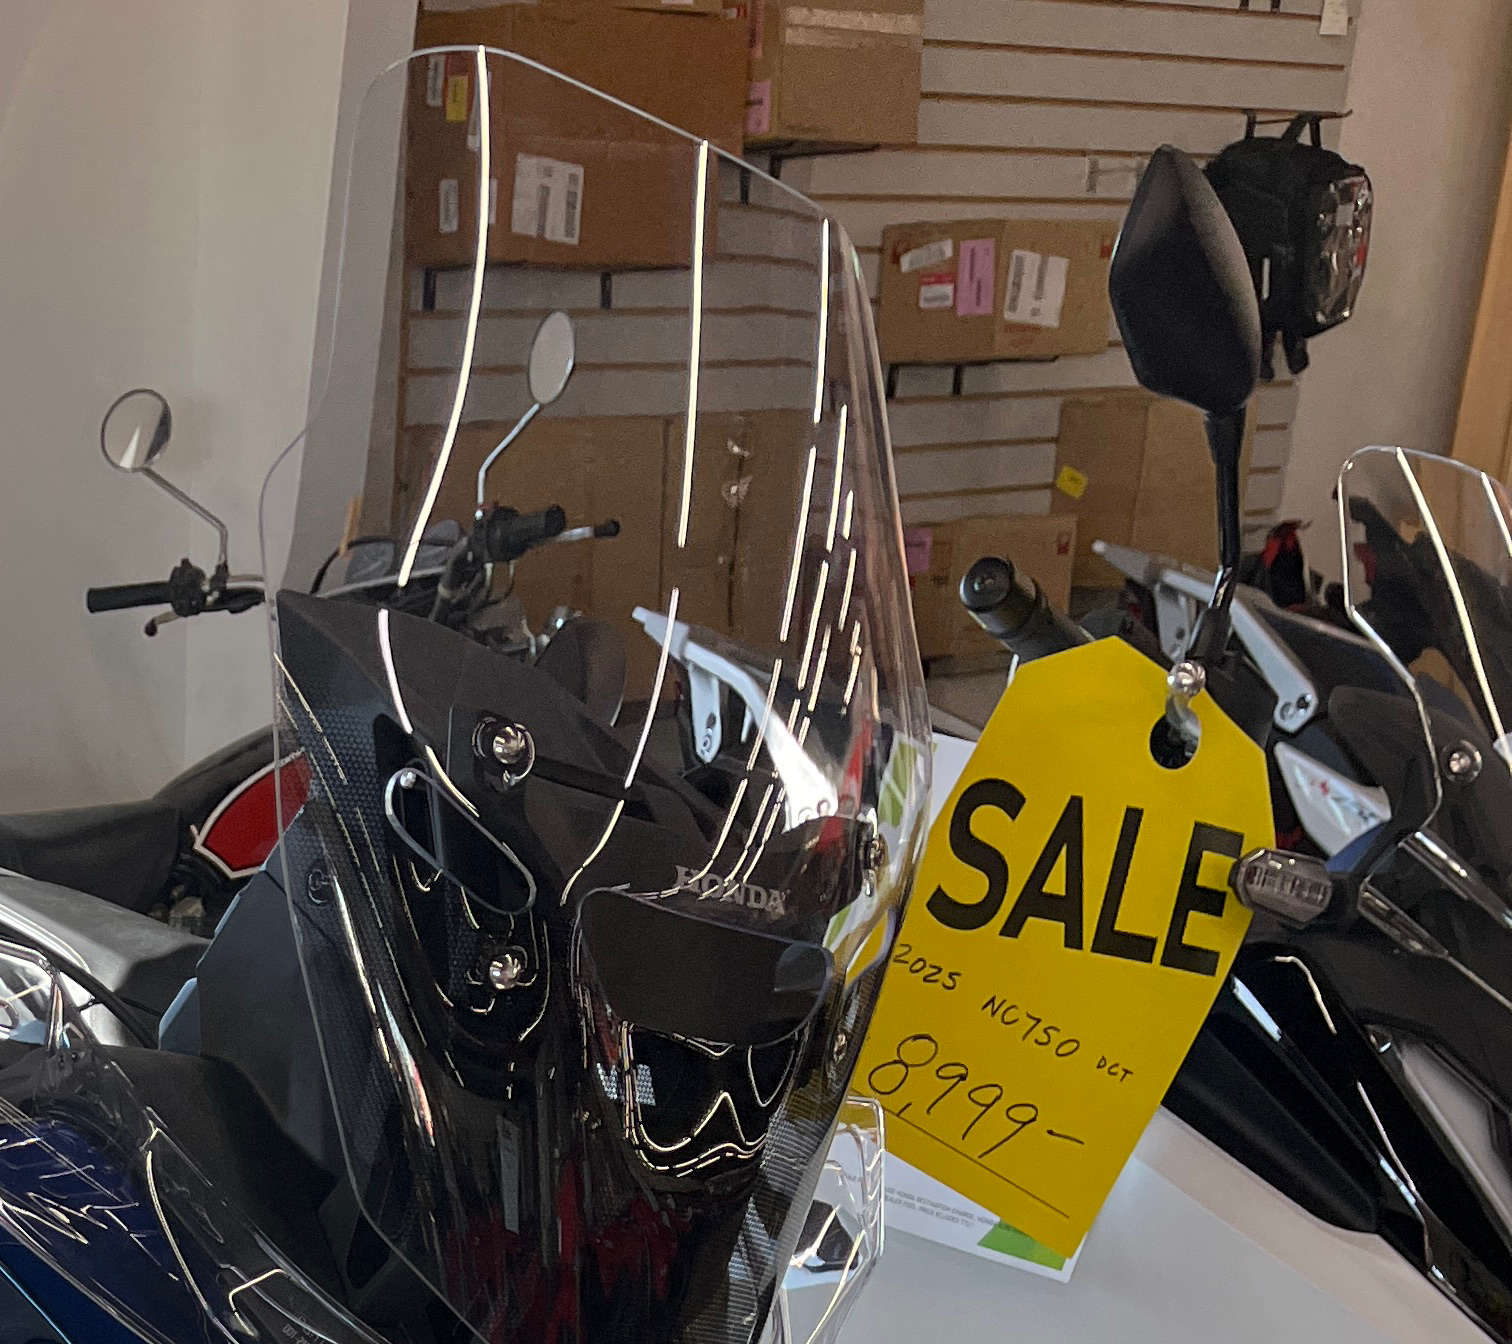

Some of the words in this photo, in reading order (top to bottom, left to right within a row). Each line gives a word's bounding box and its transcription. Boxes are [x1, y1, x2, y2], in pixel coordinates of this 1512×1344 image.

[673, 864, 786, 915] HONDA
[925, 777, 1245, 977] SALE
[891, 943, 964, 991] 2025
[981, 994, 1081, 1058] NC750
[1096, 1056, 1133, 1082] DCT
